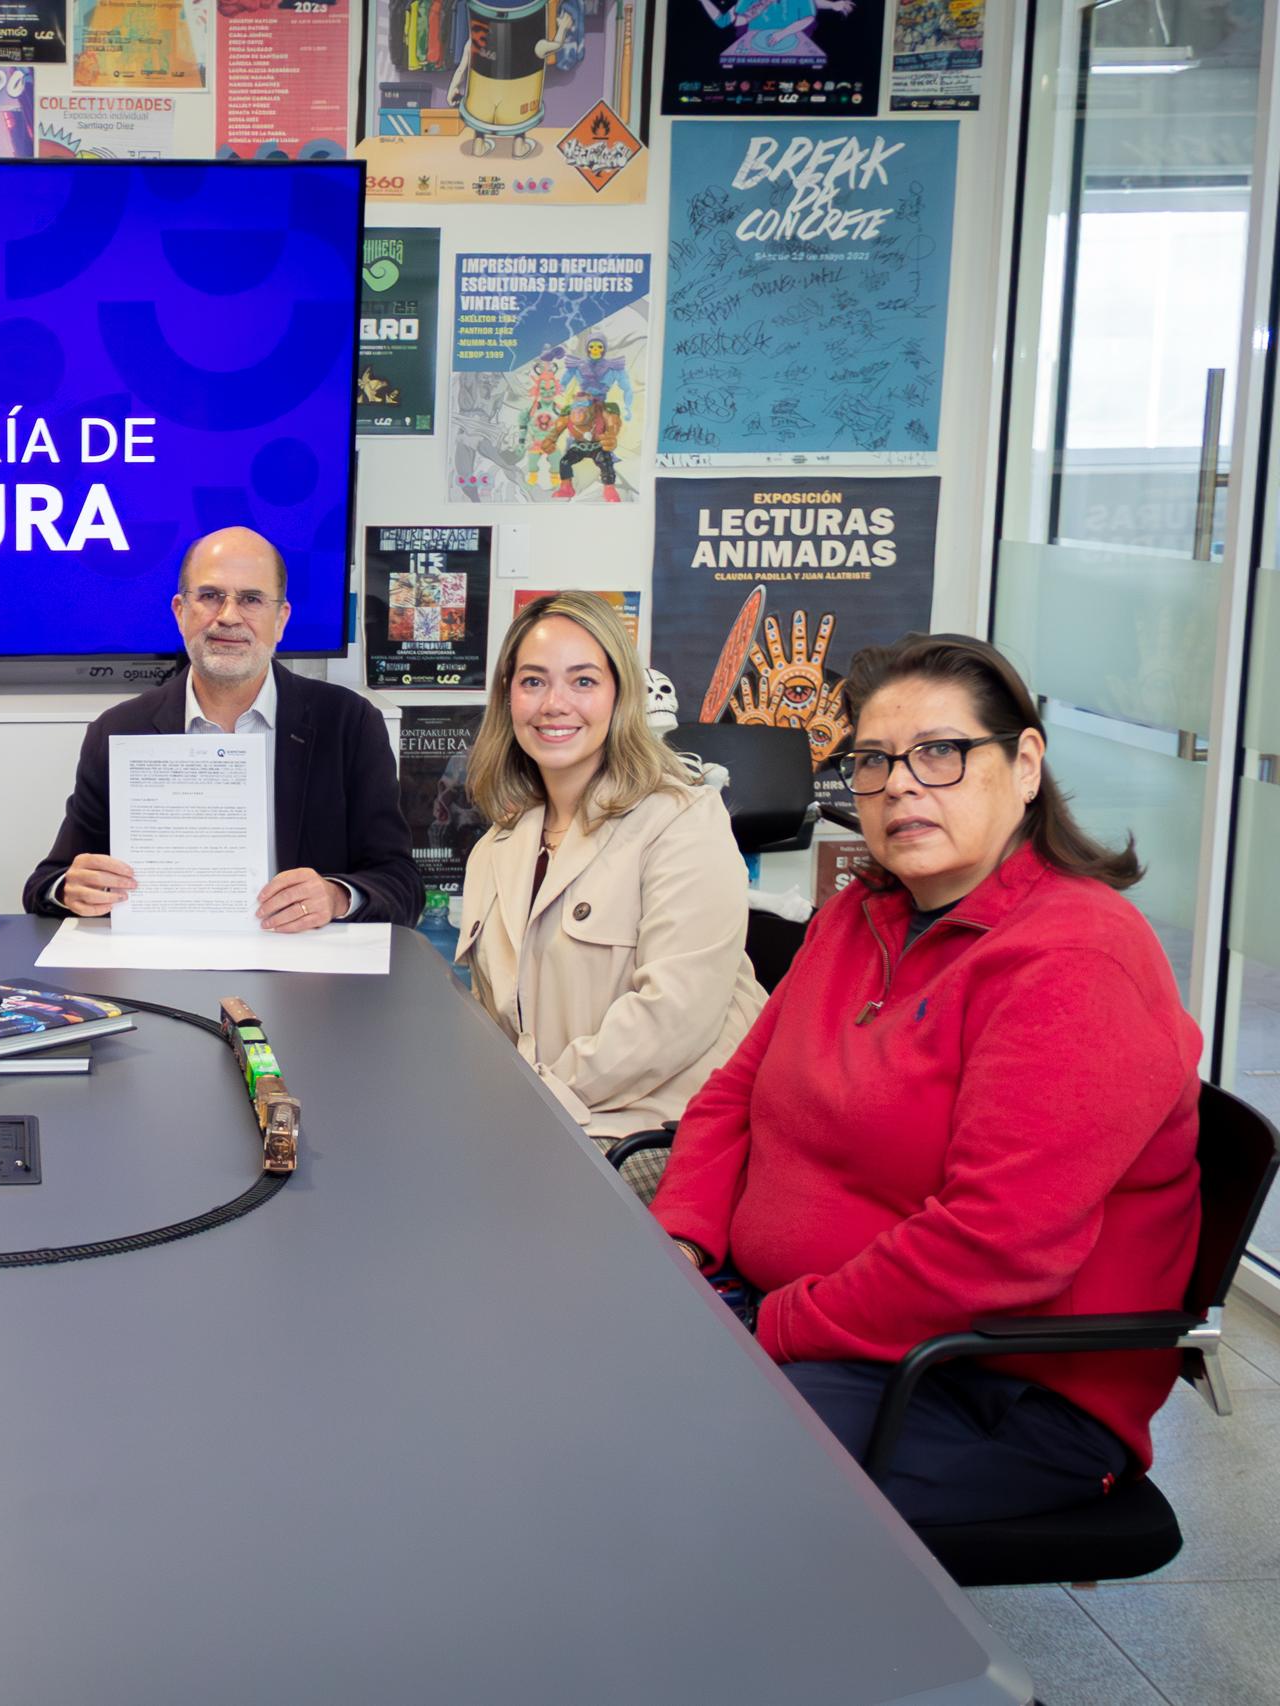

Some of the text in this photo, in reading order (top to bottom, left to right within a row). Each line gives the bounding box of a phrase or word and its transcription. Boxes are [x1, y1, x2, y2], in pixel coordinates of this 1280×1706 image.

[39, 96, 173, 111] COLECTIVIDADES
[732, 136, 906, 190] BREAK
[735, 208, 895, 241] CONCRETE
[462, 256, 644, 273] IMPRESIÓN 3D REPLICANDO
[461, 277, 634, 292] ESCULTURAS DE JUGUETES
[460, 296, 520, 311] VINTAGE.
[80, 417, 157, 464] DE
[753, 490, 842, 504] EXPOSICIÓN
[698, 507, 896, 536] LECTURAS
[691, 539, 898, 568] ANIMADAS
[714, 573, 754, 581] CLAUDIA
[754, 573, 792, 581] PADILLA
[825, 572, 871, 580] ALATRISTE
